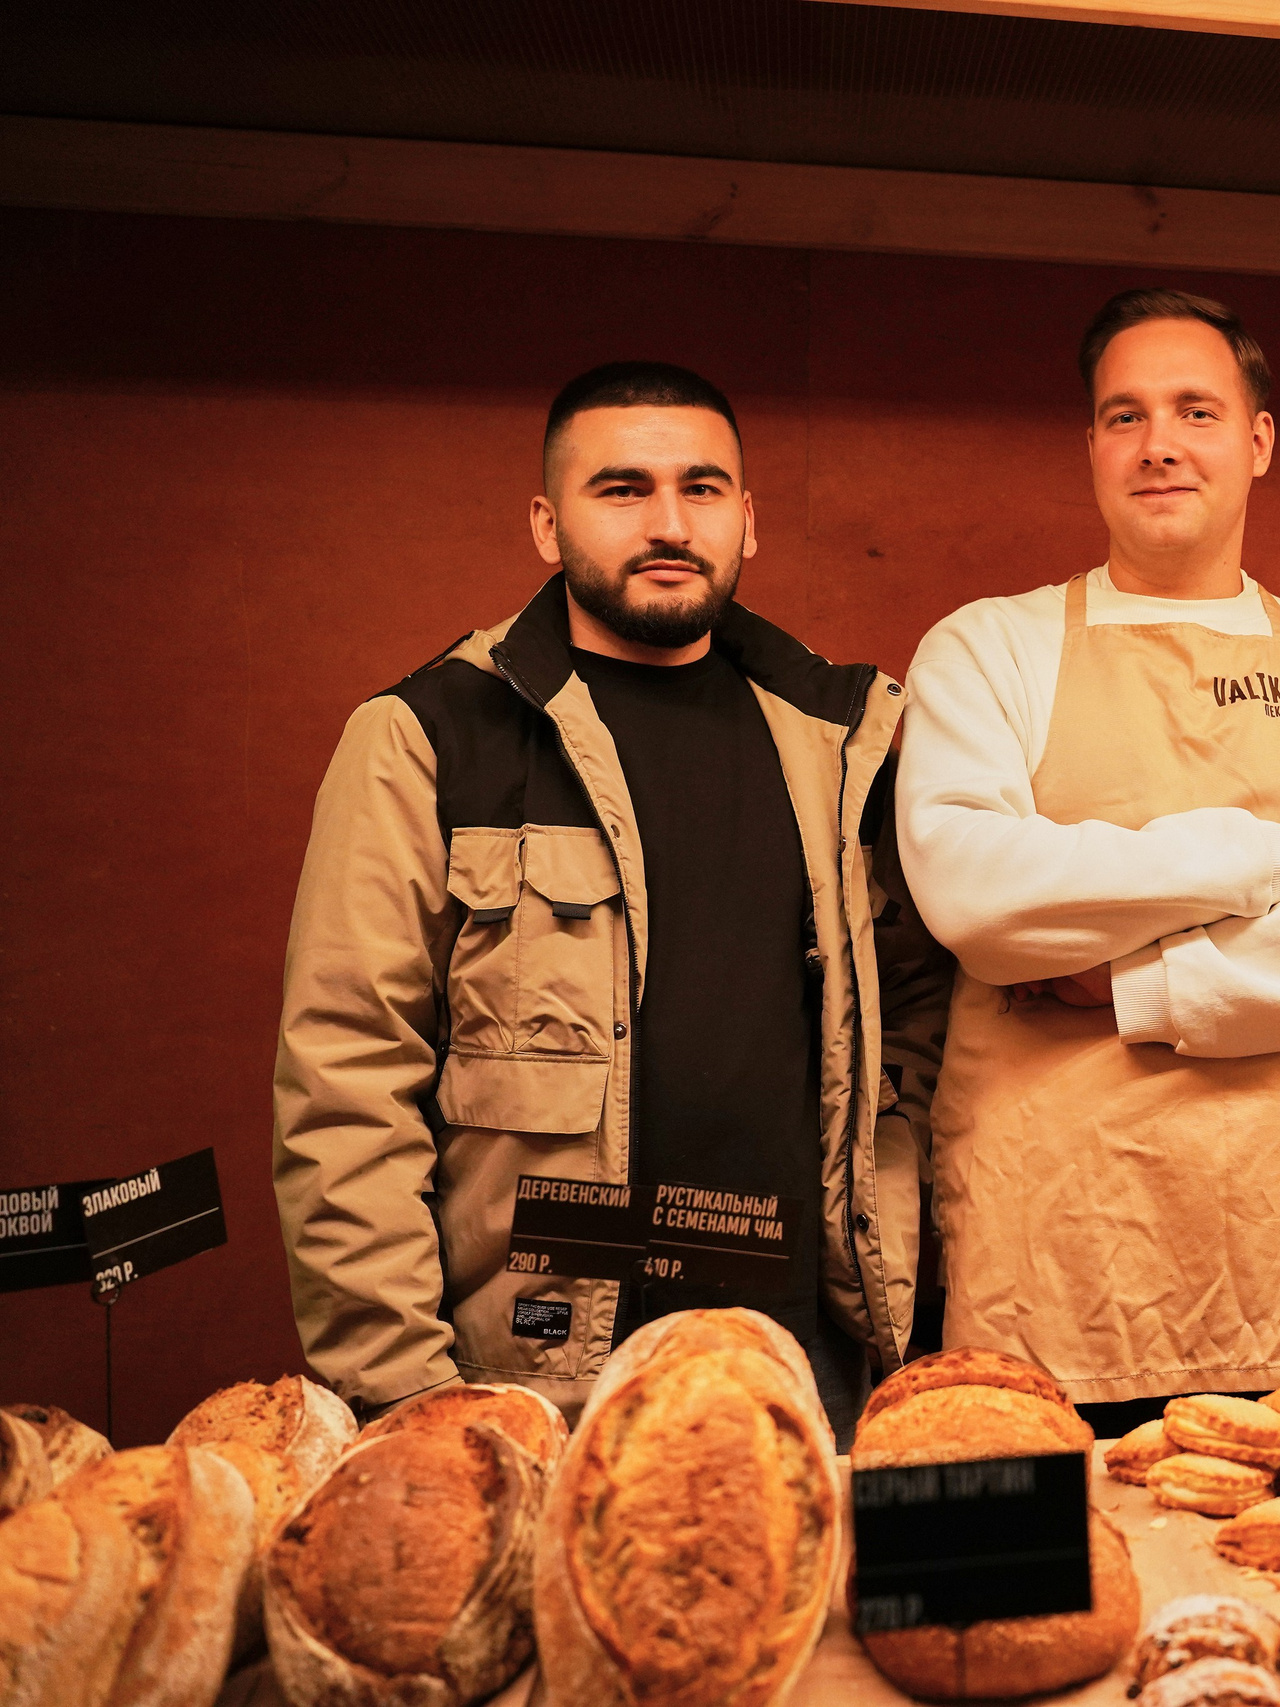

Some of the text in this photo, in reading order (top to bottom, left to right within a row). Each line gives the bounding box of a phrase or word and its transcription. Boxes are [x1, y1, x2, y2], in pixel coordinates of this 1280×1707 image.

[82, 1167, 161, 1218] ЗЛАКОВЫЙ
[517, 1178, 631, 1208] ДЕРЕВЕНСКИЙ
[656, 1184, 779, 1218] РУСТИКАЛЬНЫЙ
[652, 1206, 783, 1241] С СЕМЕНАМИ ЧИА
[123, 1260, 139, 1283] Р.
[509, 1252, 552, 1274] 290 Р.
[644, 1256, 685, 1280] 410 Р.
[543, 1328, 568, 1336] BLACK
